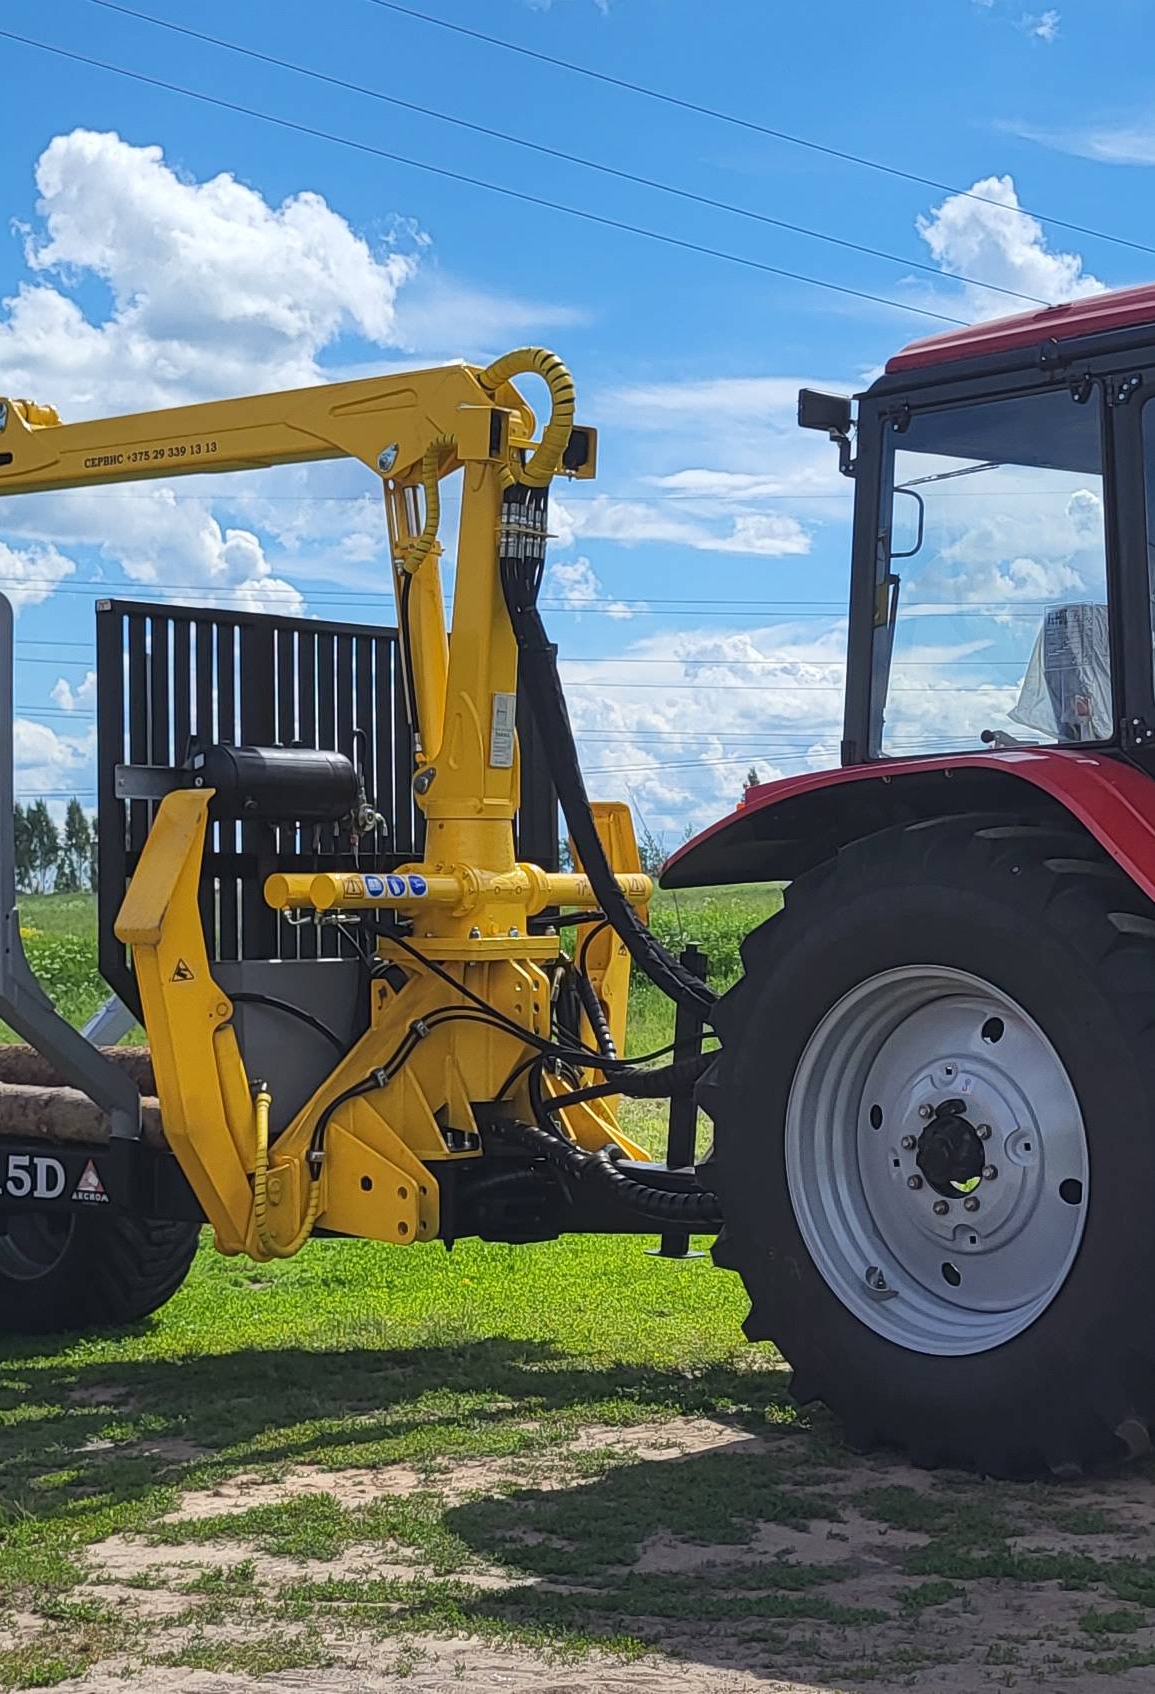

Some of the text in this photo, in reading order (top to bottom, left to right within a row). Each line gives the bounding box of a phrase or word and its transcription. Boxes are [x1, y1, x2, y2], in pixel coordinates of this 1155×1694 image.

[84, 442, 217, 468] СЕРВИС +375 29 339 13 13
